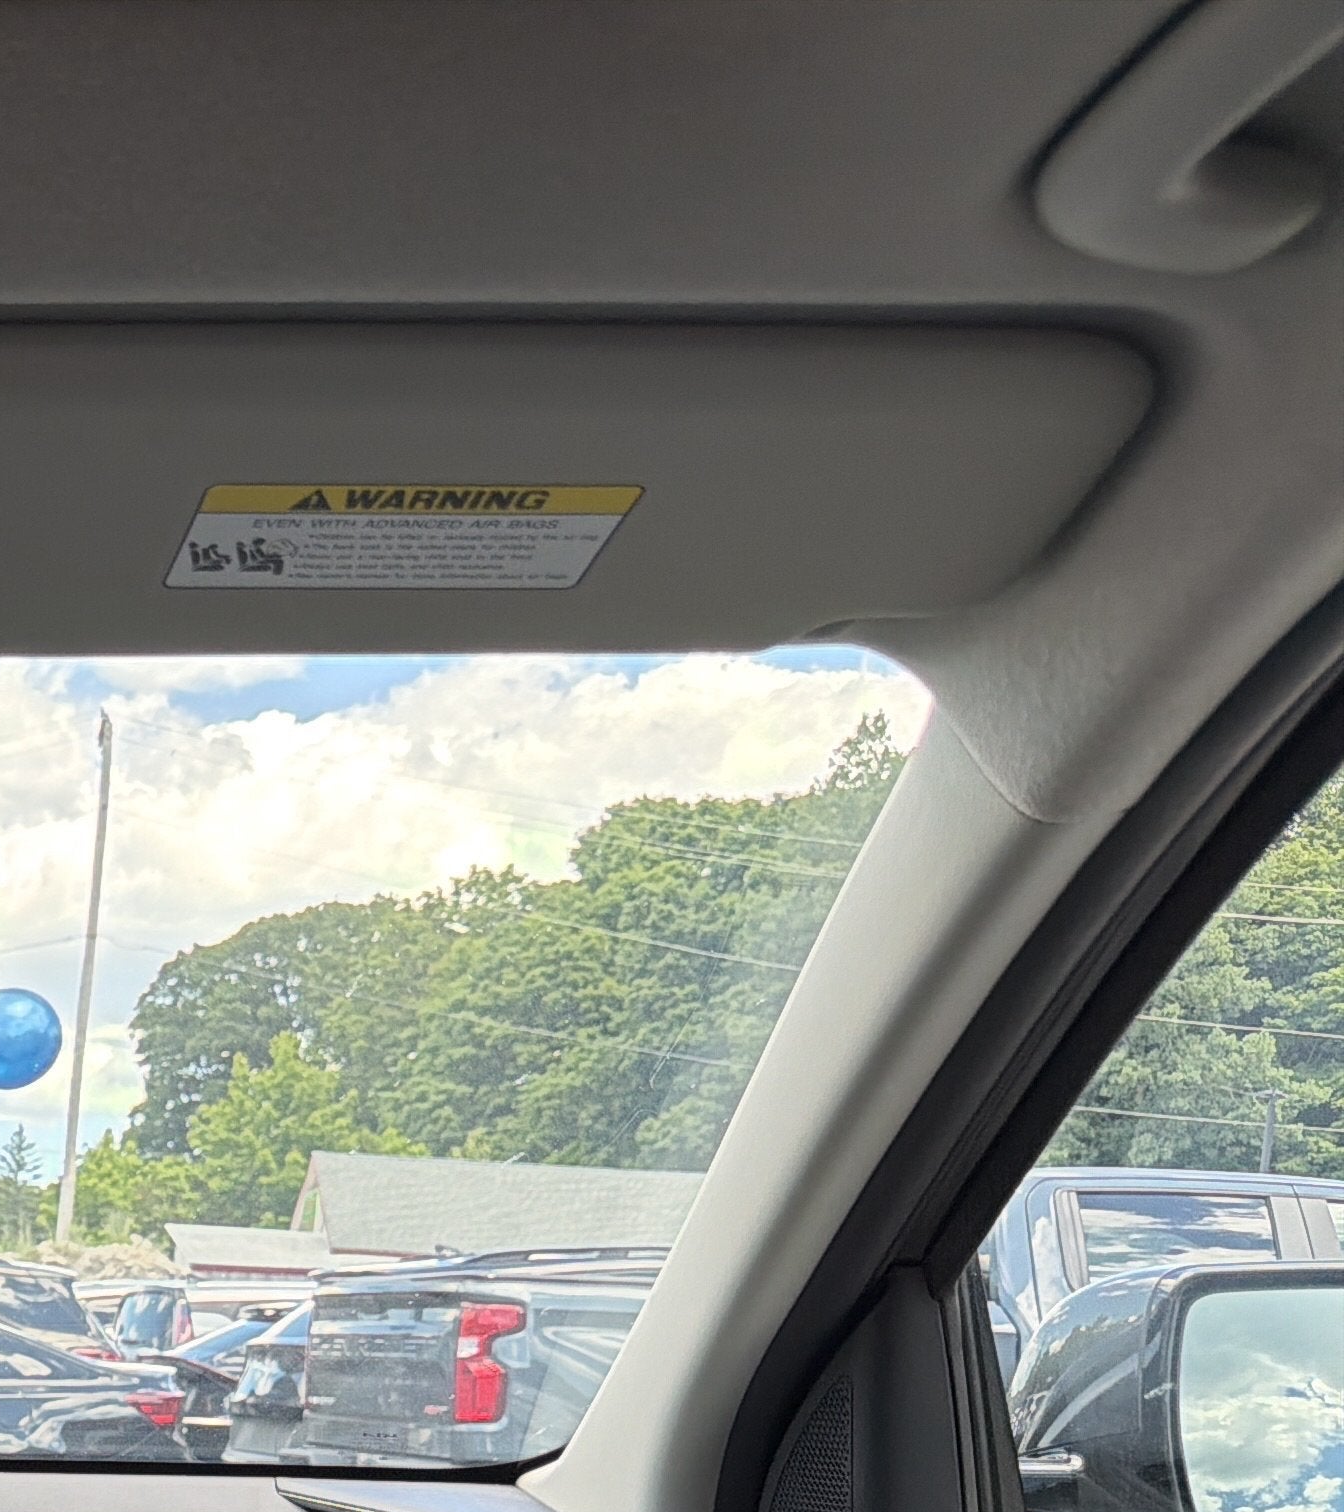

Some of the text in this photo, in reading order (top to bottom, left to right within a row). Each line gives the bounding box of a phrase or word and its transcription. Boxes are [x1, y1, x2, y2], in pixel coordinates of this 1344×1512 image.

[344, 489, 550, 511] WARNING
[252, 518, 560, 530] EVEN WITH ADVANCED AIR BAGS
